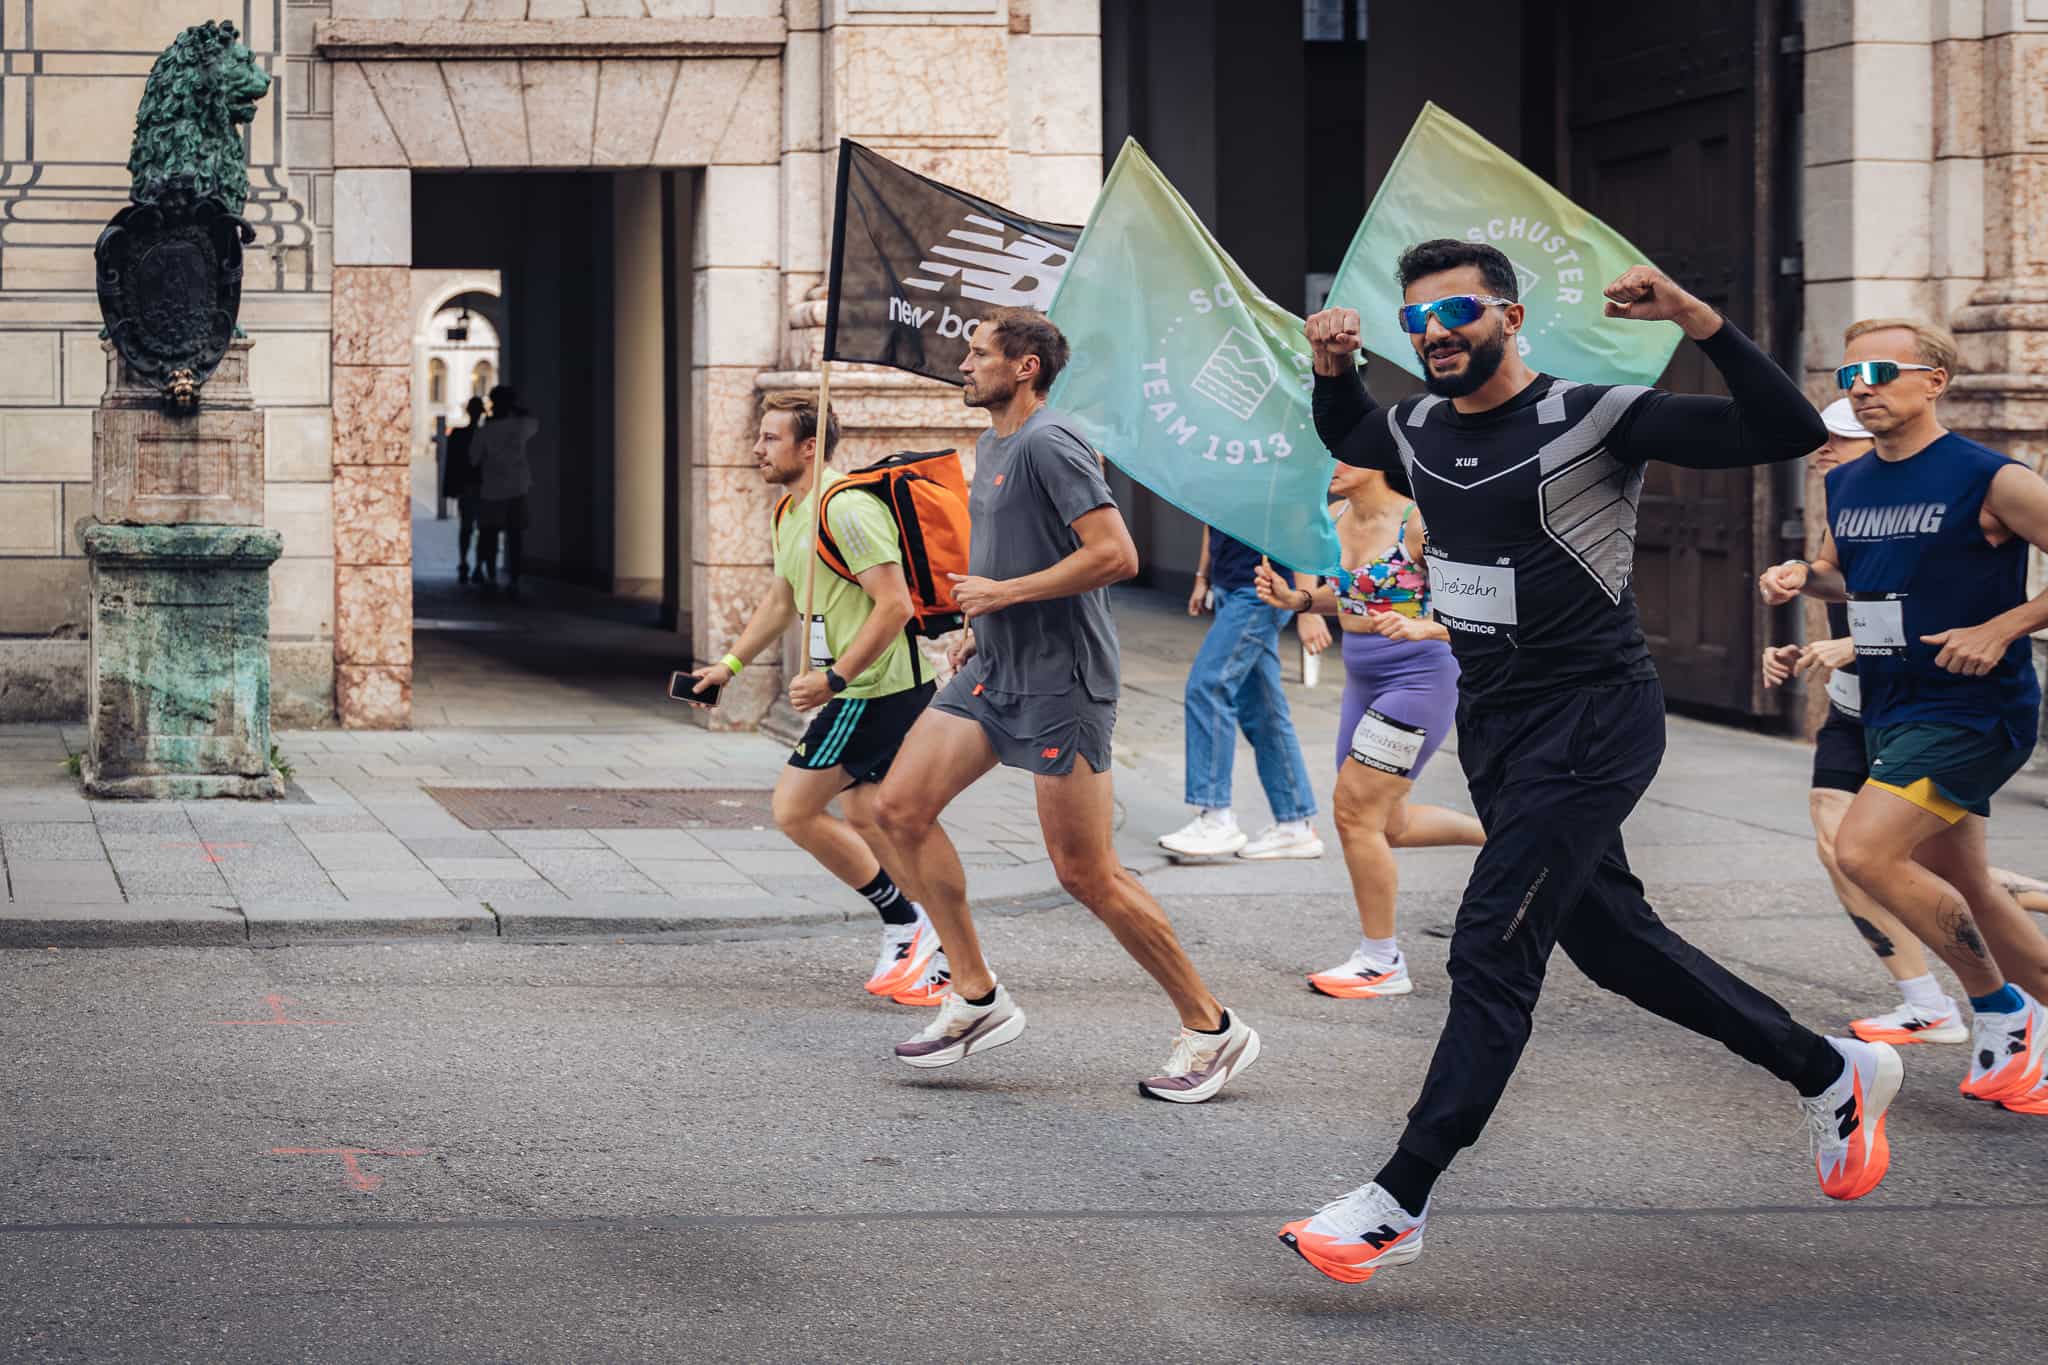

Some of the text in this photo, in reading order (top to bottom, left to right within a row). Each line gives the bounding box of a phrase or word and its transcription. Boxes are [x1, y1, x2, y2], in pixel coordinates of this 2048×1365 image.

[1142, 357, 1293, 465] TEAM 1913
[1834, 502, 1947, 538] RUNNING
[1431, 566, 1497, 598] Dreizehn
[1452, 618, 1496, 635] balance
